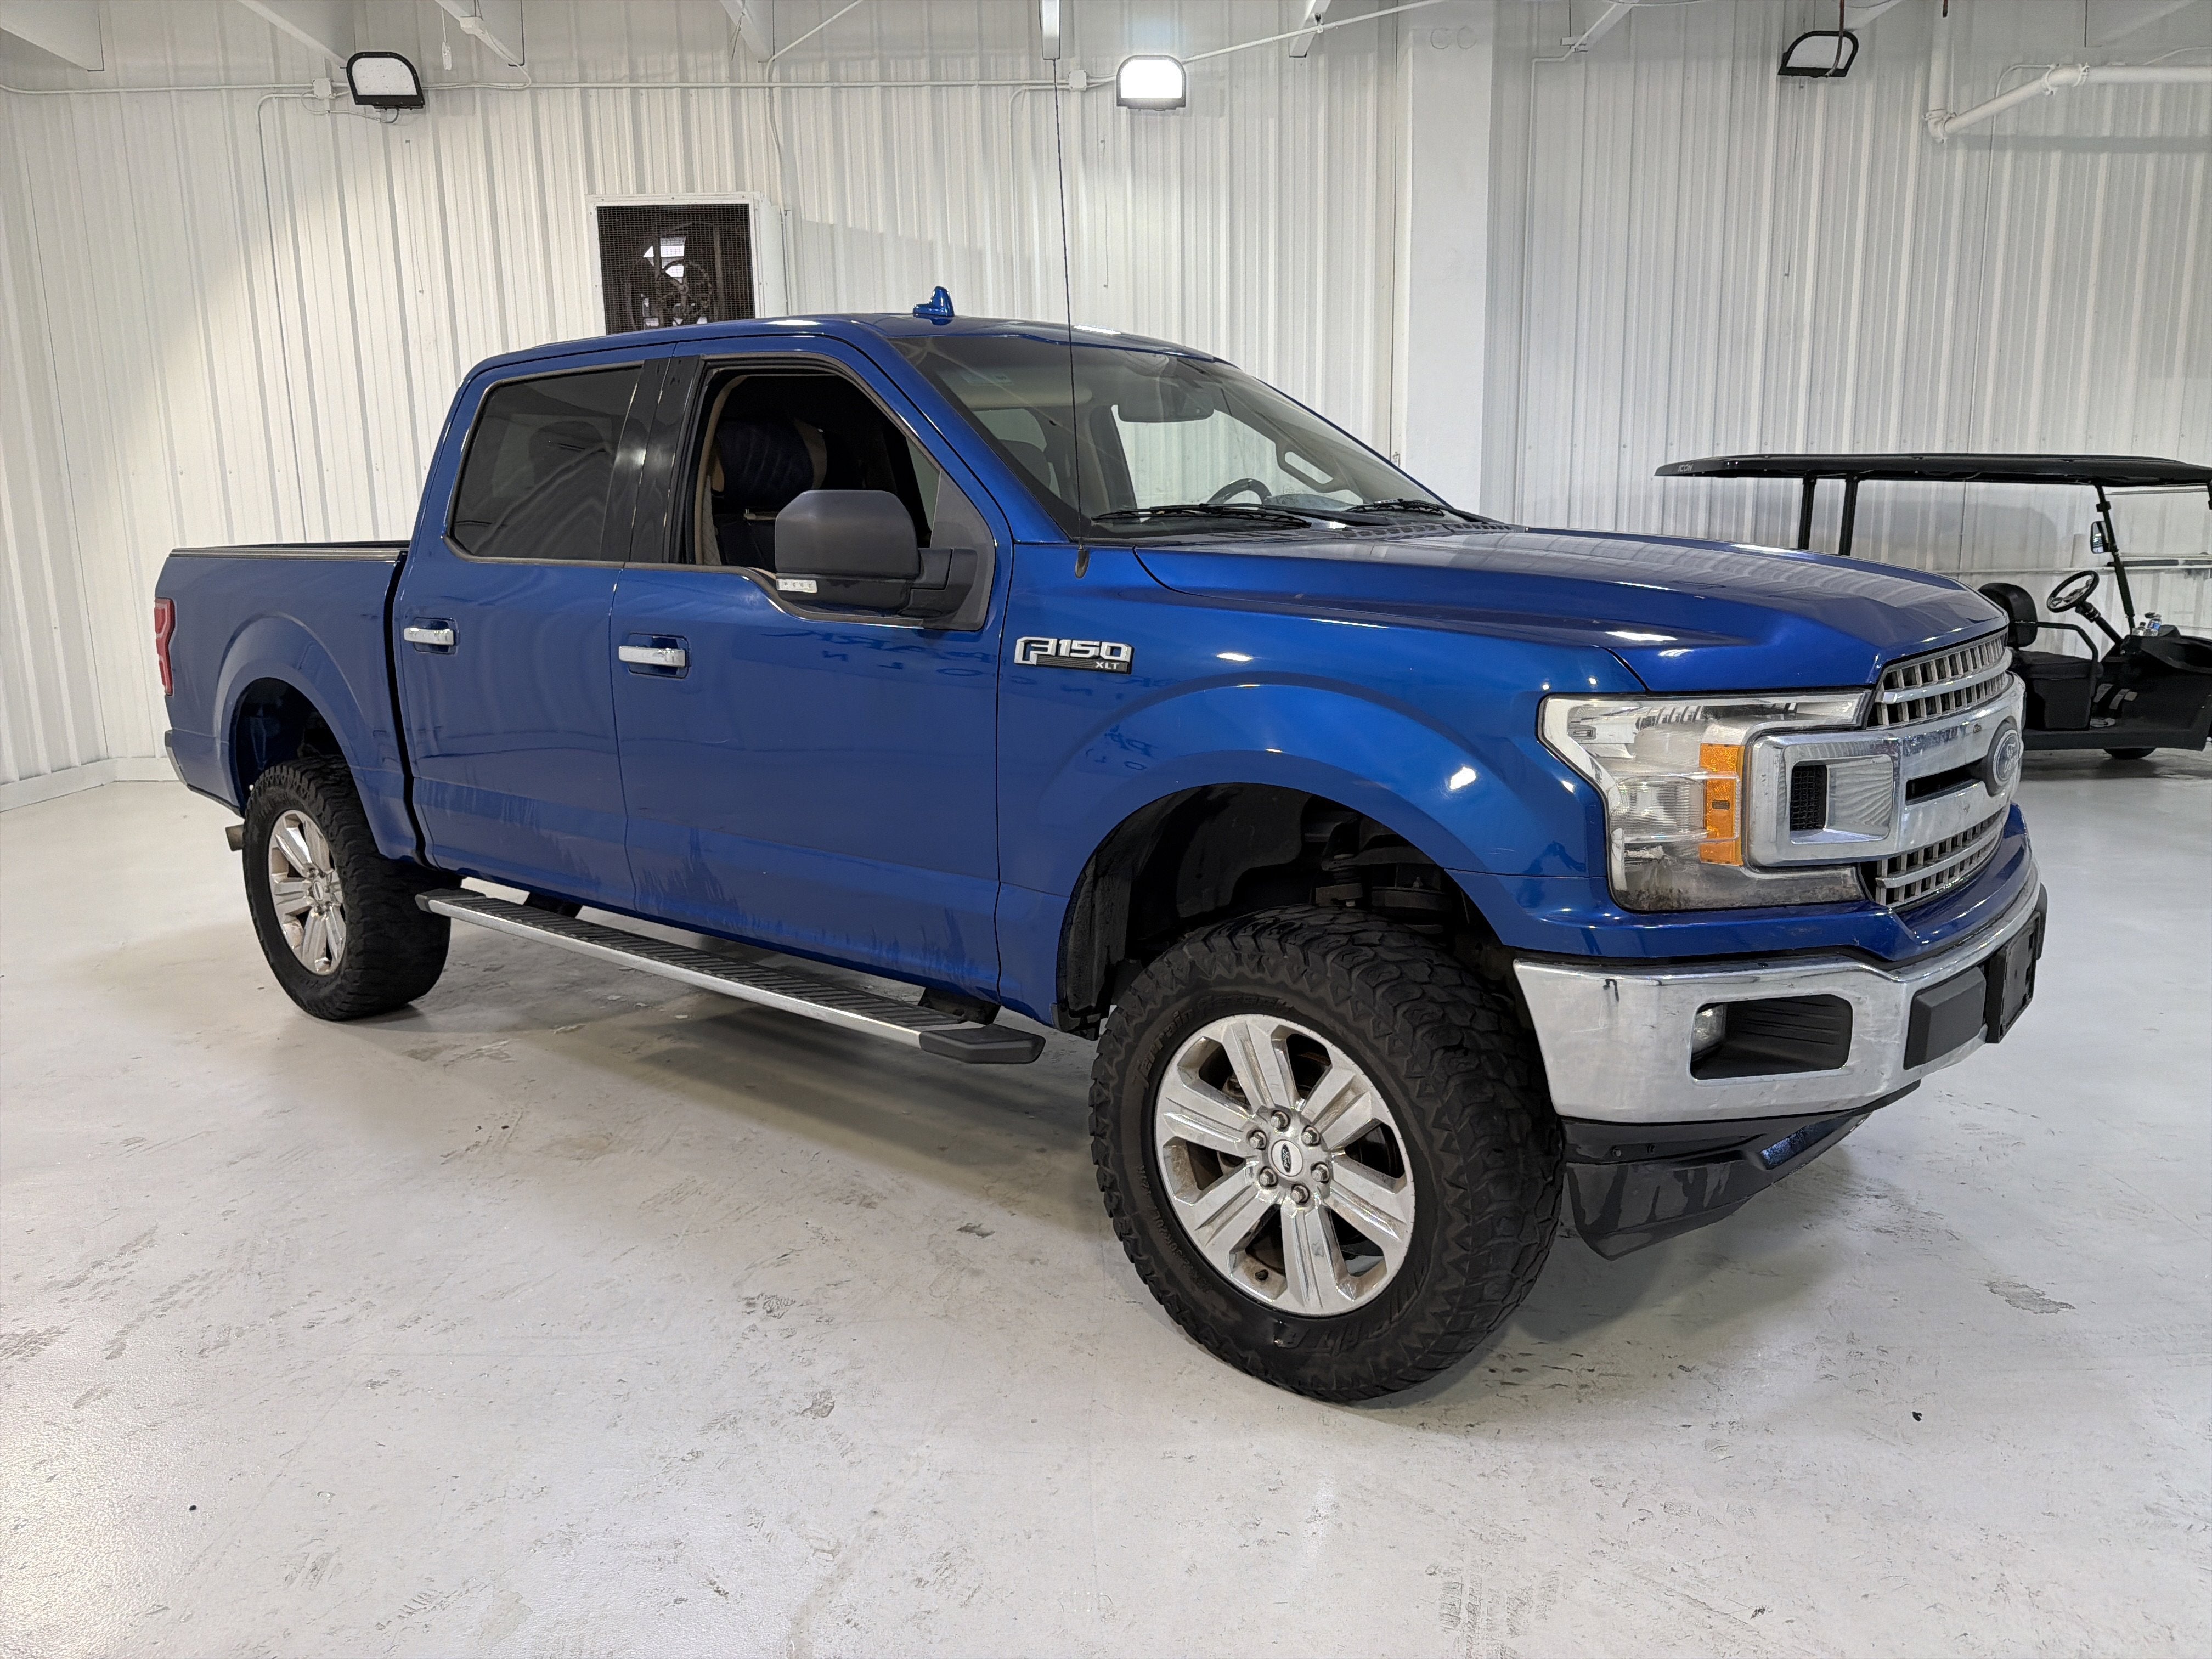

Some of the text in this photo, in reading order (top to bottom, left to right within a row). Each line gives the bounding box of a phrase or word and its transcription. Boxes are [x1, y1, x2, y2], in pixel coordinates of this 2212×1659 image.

[1095, 661, 1120, 670] XLT
[1132, 1009, 1193, 1088] Terrain
[1282, 1149, 1290, 1169] Ford
